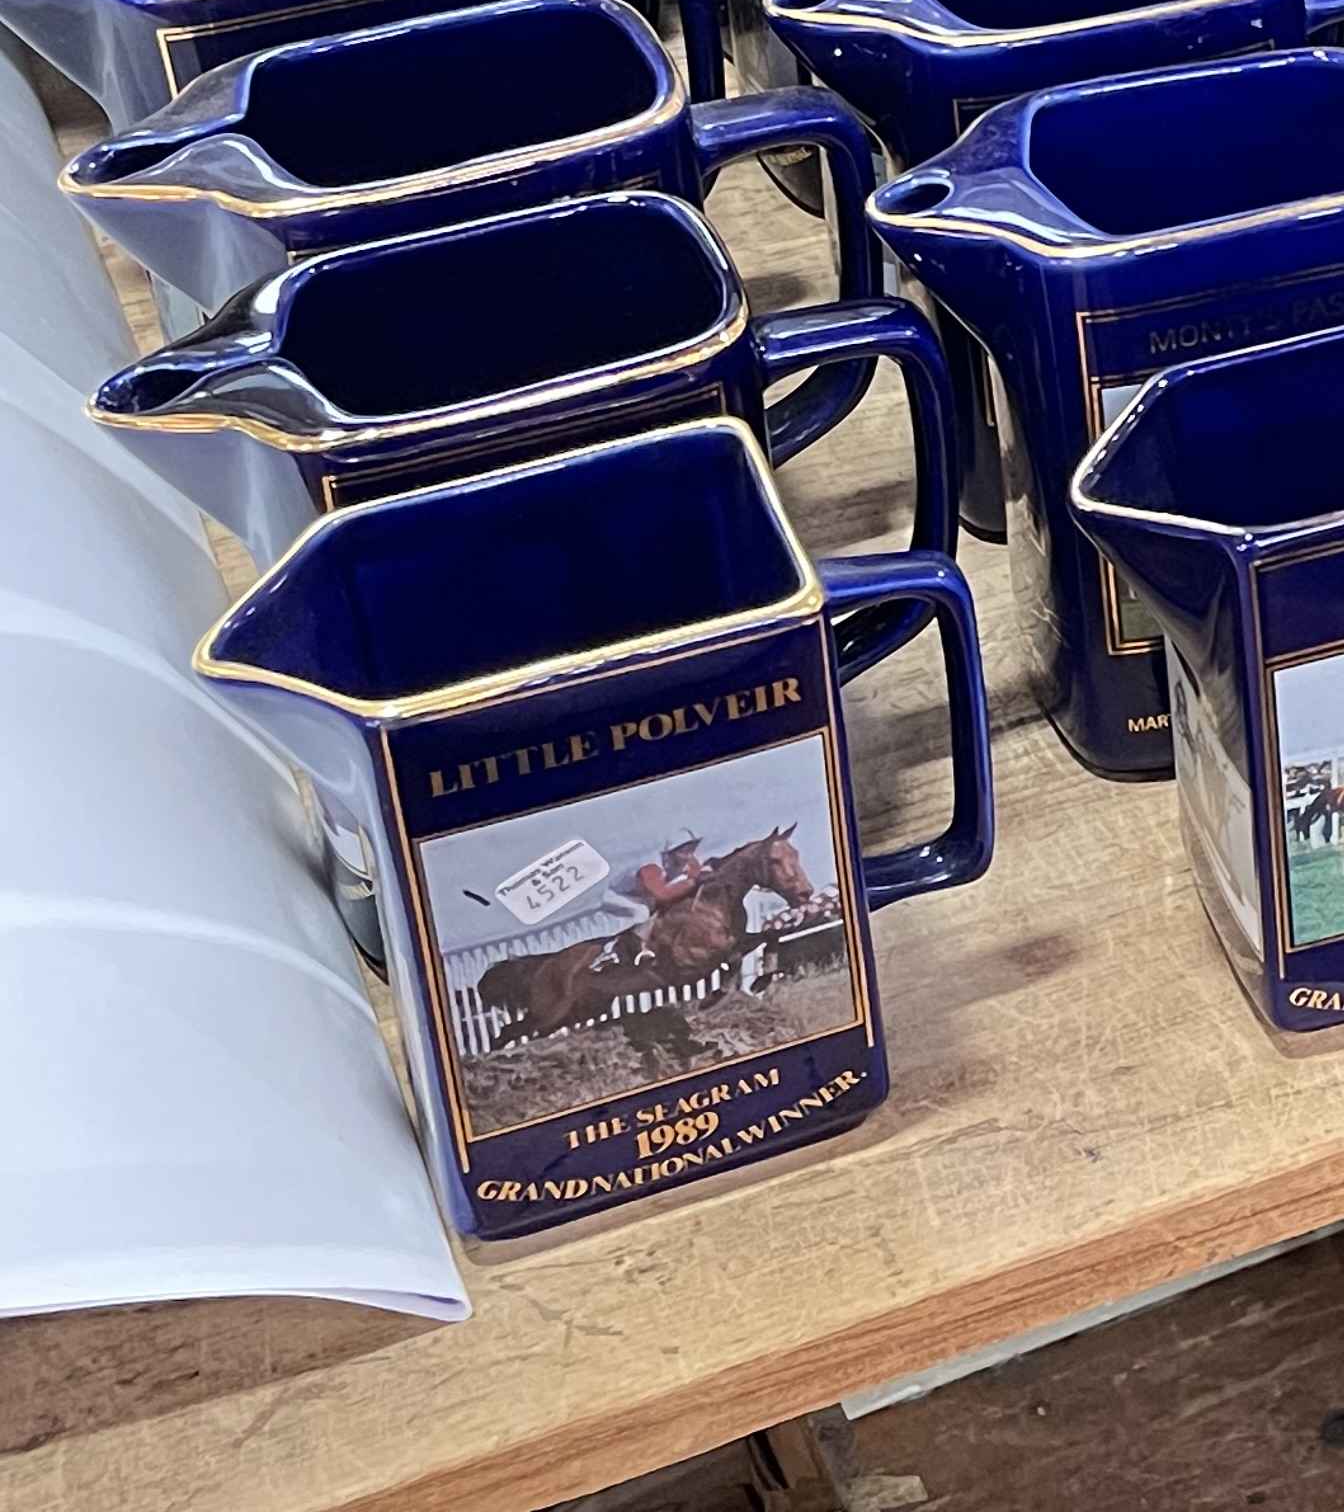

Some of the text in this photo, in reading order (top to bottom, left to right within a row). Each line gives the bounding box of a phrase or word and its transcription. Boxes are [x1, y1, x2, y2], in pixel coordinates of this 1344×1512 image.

[429, 675, 803, 799] LITTLE POLVEIR
[563, 1067, 781, 1151] THE SEAGRAM
[633, 1111, 720, 1160] 1989
[477, 1178, 590, 1202] GRAND
[589, 1136, 743, 1195] NATIONAL
